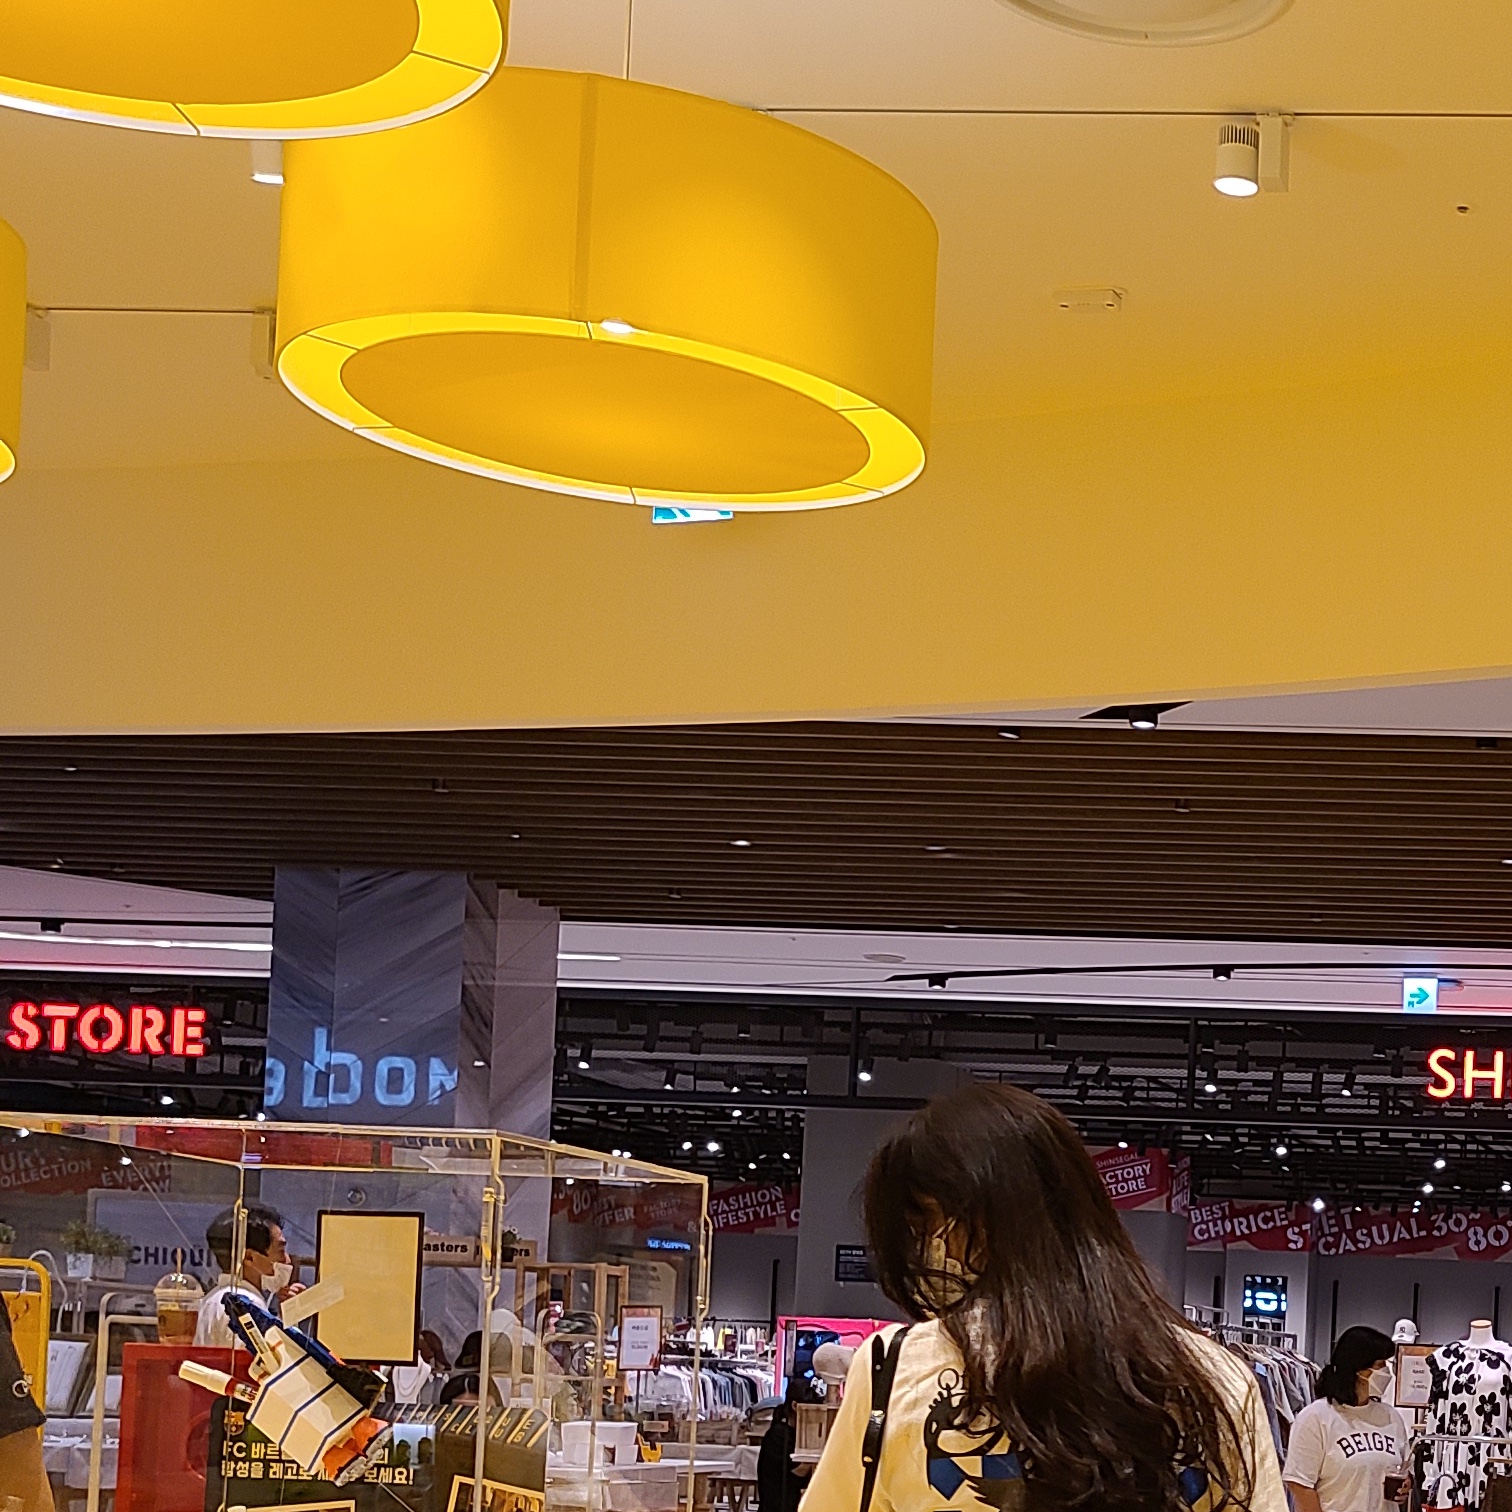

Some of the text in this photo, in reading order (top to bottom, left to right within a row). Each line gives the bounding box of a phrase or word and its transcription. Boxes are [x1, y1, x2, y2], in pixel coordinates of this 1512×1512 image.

[5, 1002, 207, 1056] STORE
[709, 1186, 784, 1216] FASHION
[1190, 1201, 1230, 1224] BEST
[1318, 1217, 1427, 1256] CASUAL
[223, 1441, 247, 1459] FC
[1336, 1431, 1396, 1459] BEIGE
